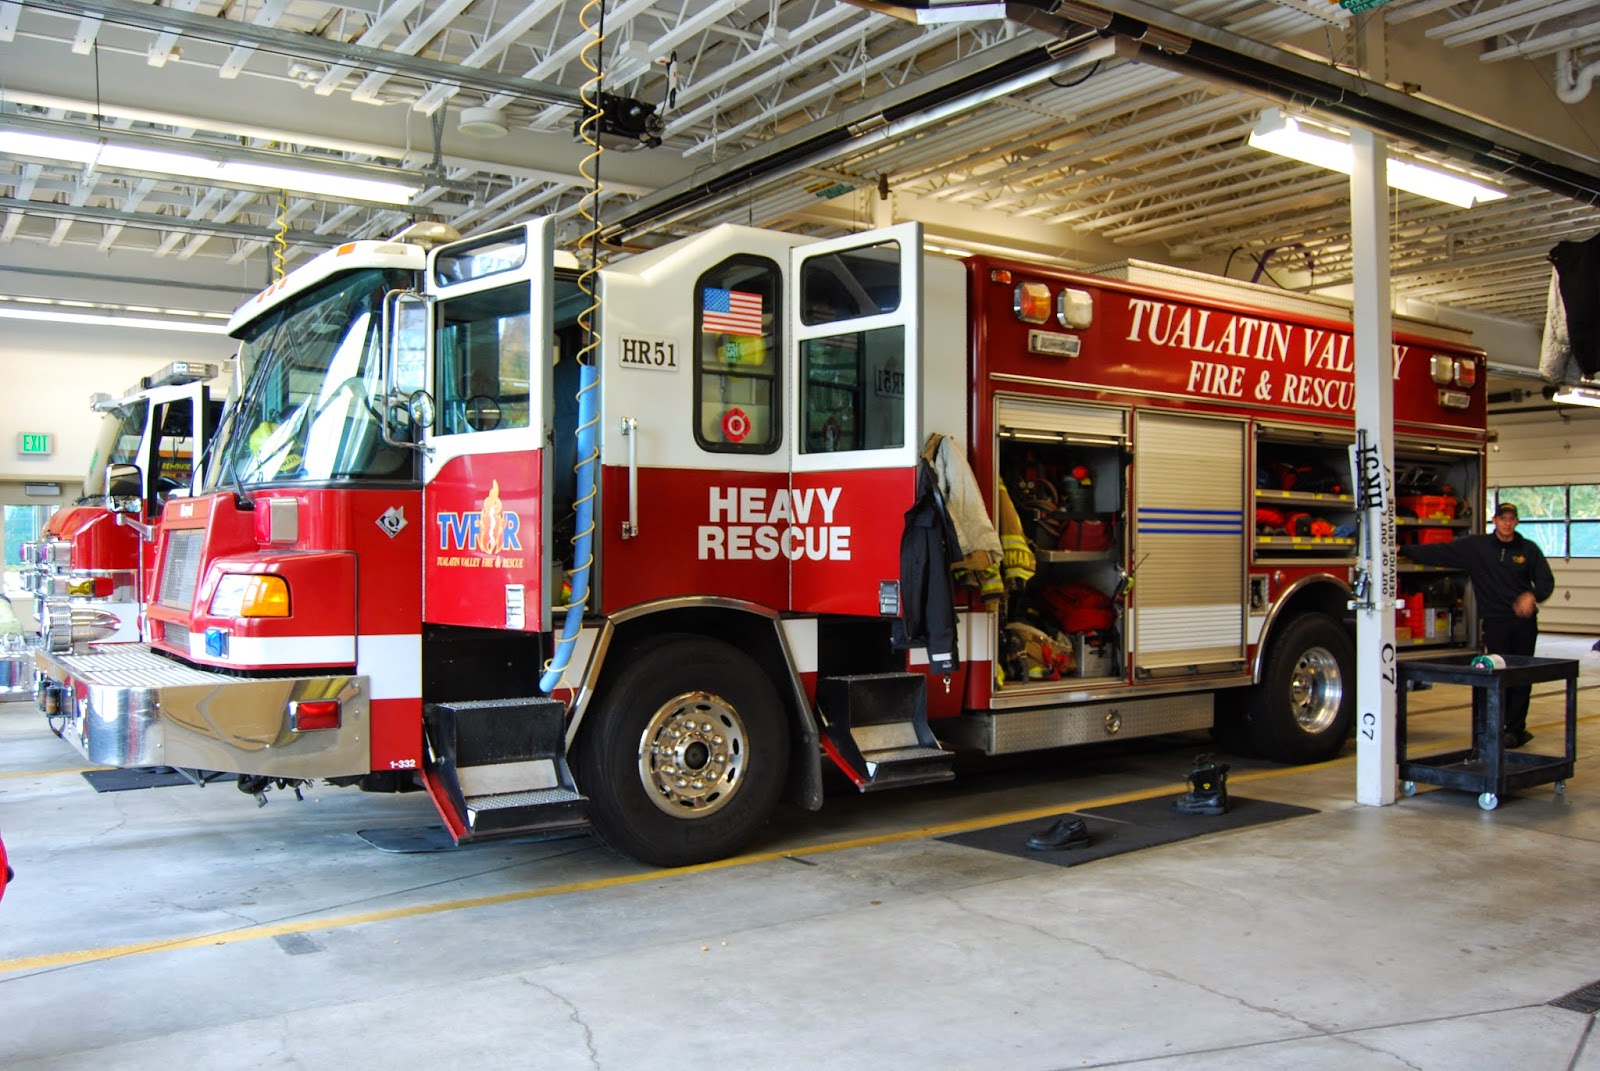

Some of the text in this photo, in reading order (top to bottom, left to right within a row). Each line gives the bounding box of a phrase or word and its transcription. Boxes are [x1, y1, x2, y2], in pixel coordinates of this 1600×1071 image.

[622, 338, 676, 367] HR51
[1126, 298, 1409, 380] TUALATIN VALY
[1186, 360, 1356, 411] FIRE & RESCU
[23, 434, 48, 452] EXIT
[709, 486, 843, 524] HEAVY
[698, 525, 851, 561] RESCUE
[1383, 552, 1389, 566] OF
[1381, 643, 1395, 685] C7
[1362, 712, 1376, 740] C7
[389, 758, 416, 769] 1-332
